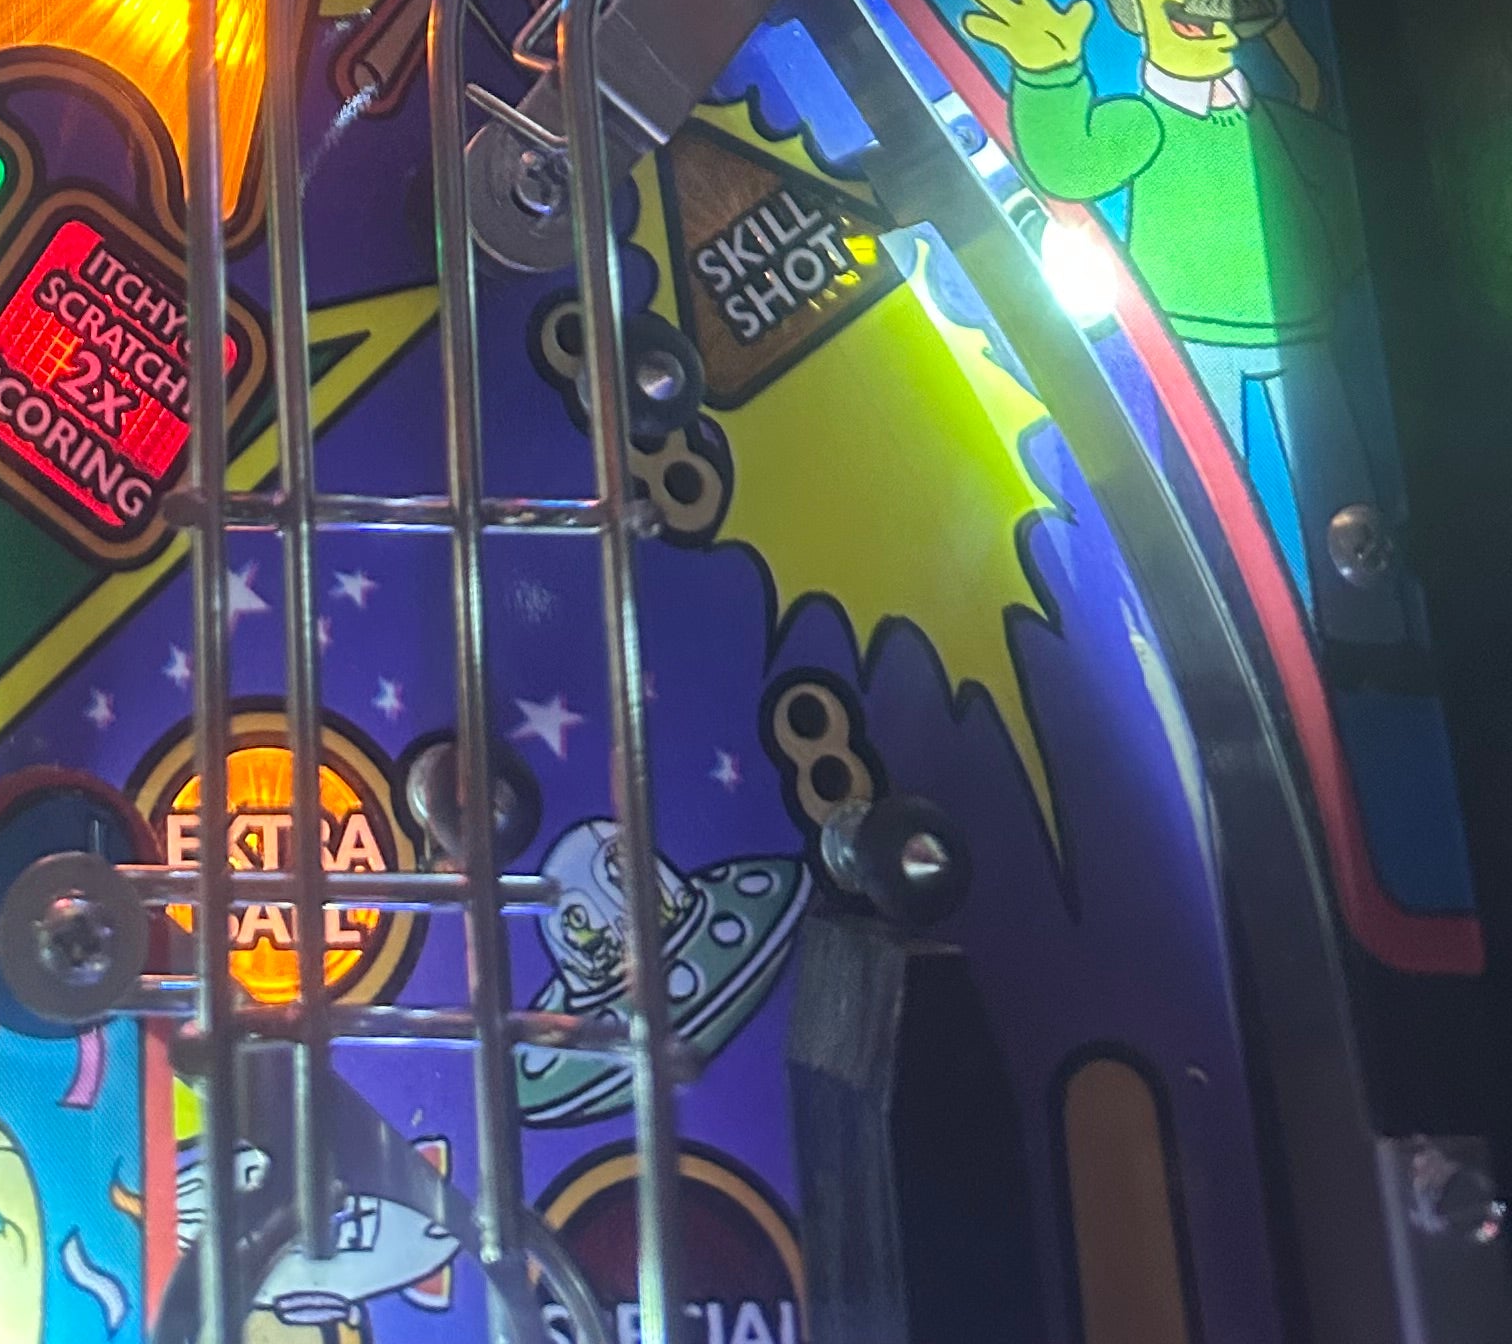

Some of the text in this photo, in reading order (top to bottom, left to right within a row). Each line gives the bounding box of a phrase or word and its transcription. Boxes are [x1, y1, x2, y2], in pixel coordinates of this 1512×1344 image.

[87, 248, 187, 336] ITCHY
[696, 189, 822, 293] SKILL
[725, 222, 848, 339] SHOT
[39, 275, 193, 415] SCRATCH
